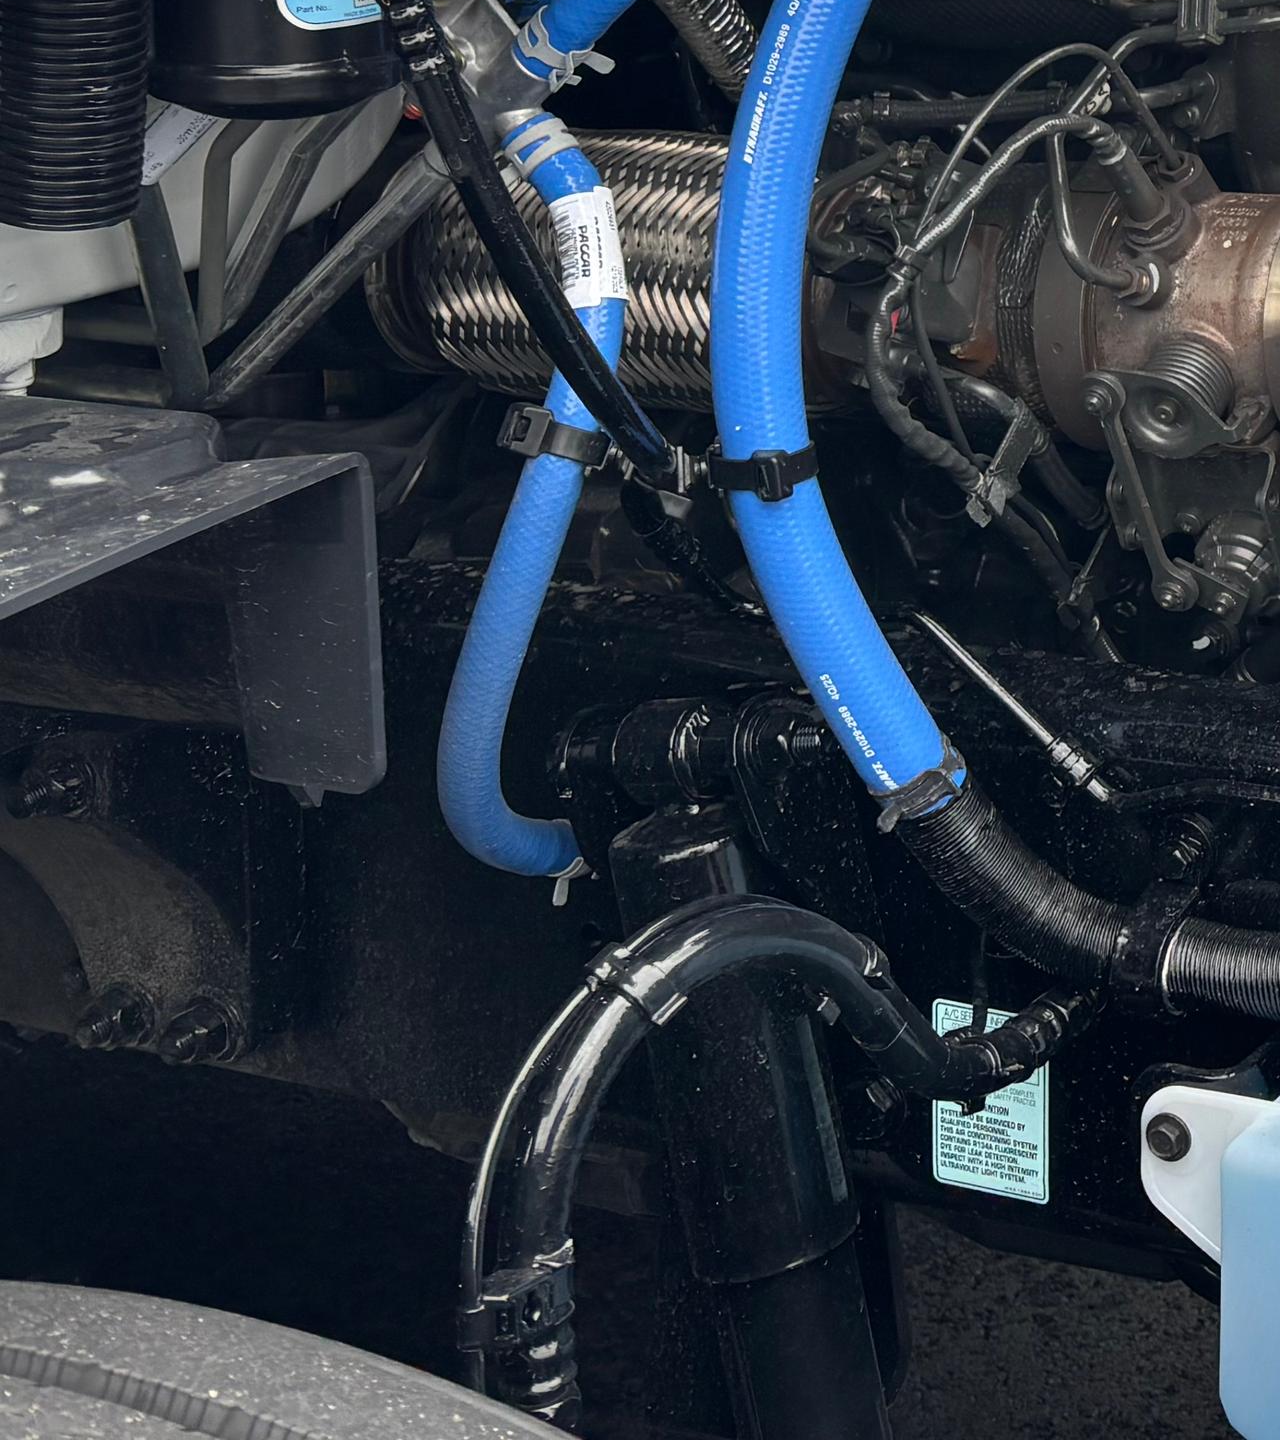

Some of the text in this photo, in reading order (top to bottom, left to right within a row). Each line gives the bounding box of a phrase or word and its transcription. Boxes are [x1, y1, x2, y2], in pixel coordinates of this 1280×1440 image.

[763, 23, 791, 85] D1029-2989
[578, 225, 591, 278] PACCAR
[820, 674, 875, 758] D1029-2989 4Q/25
[941, 1116, 1010, 1137] QUALIFIED PERSONNEL.
[976, 1115, 1025, 1131] BE SERVICED BY
[941, 1125, 954, 1134] THIS
[967, 1131, 1011, 1145] CONDITIONING
[1013, 1140, 1037, 1151] SYSTEM
[941, 1134, 1037, 1160] CONTAINS R134A FLUORESCENT
[941, 1143, 1019, 1165] DYE FOR LEAK DETECTION.
[941, 1151, 965, 1161] INSPECT
[967, 1156, 983, 1165] WITH
[991, 1161, 1006, 1170] HIGH
[1008, 1166, 1039, 1177] INTENSITY
[941, 1161, 1026, 1183] ULTRAVIOLET LIGHT SYSTEM.
